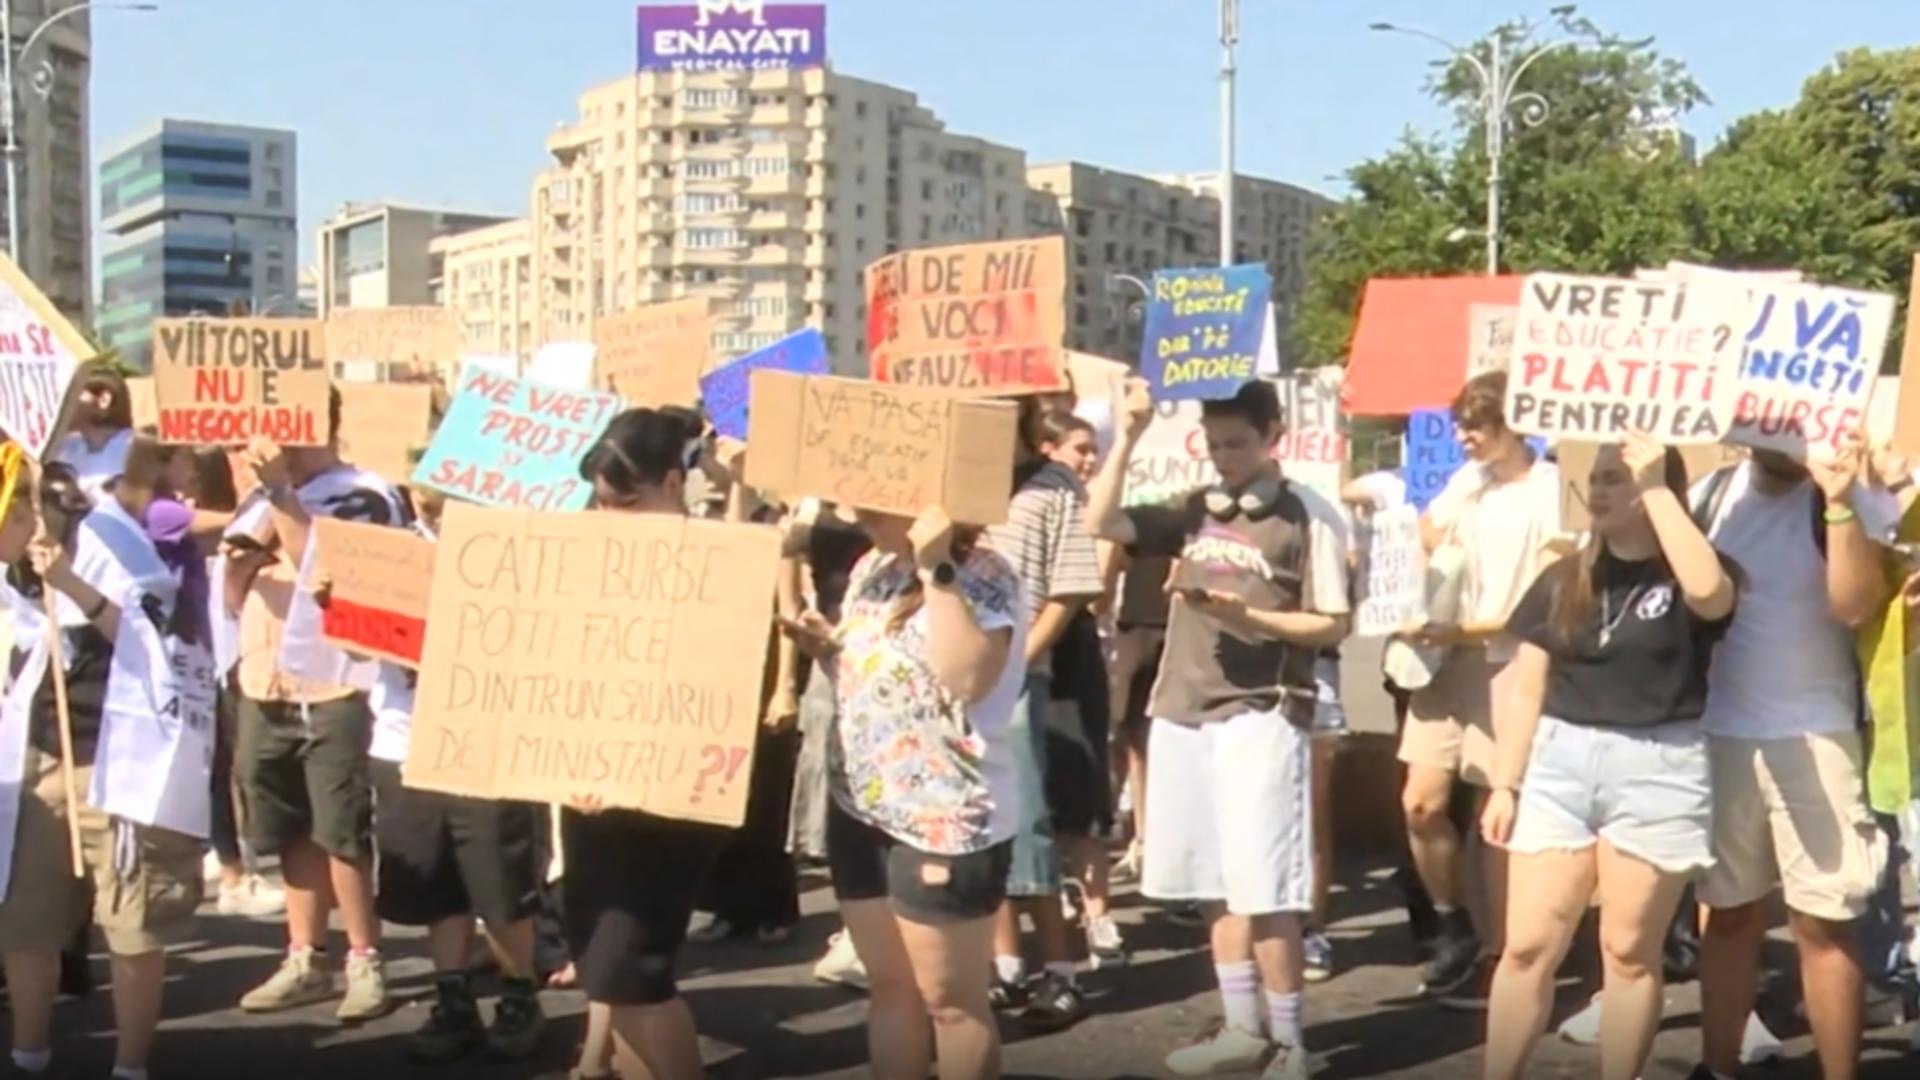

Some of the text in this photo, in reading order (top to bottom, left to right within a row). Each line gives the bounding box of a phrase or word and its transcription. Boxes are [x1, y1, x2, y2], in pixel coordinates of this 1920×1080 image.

[654, 29, 811, 55] ENAYATI
[923, 254, 964, 295] DE
[920, 299, 1008, 341] VOCI
[1795, 296, 1868, 362] VĂ
[159, 318, 324, 370] VIITORUL
[194, 369, 279, 406] NU E
[466, 371, 519, 405] NE
[1163, 351, 1255, 387] DATORIE
[160, 404, 318, 443] NEGOCIABIL
[1512, 392, 1720, 437] PENTRU EA
[1733, 390, 1861, 452] BURSE
[456, 531, 579, 597] CATE
[600, 535, 731, 603] BURSE
[455, 601, 559, 659] POTI
[580, 611, 673, 666] FACE
[433, 725, 475, 773] DE
